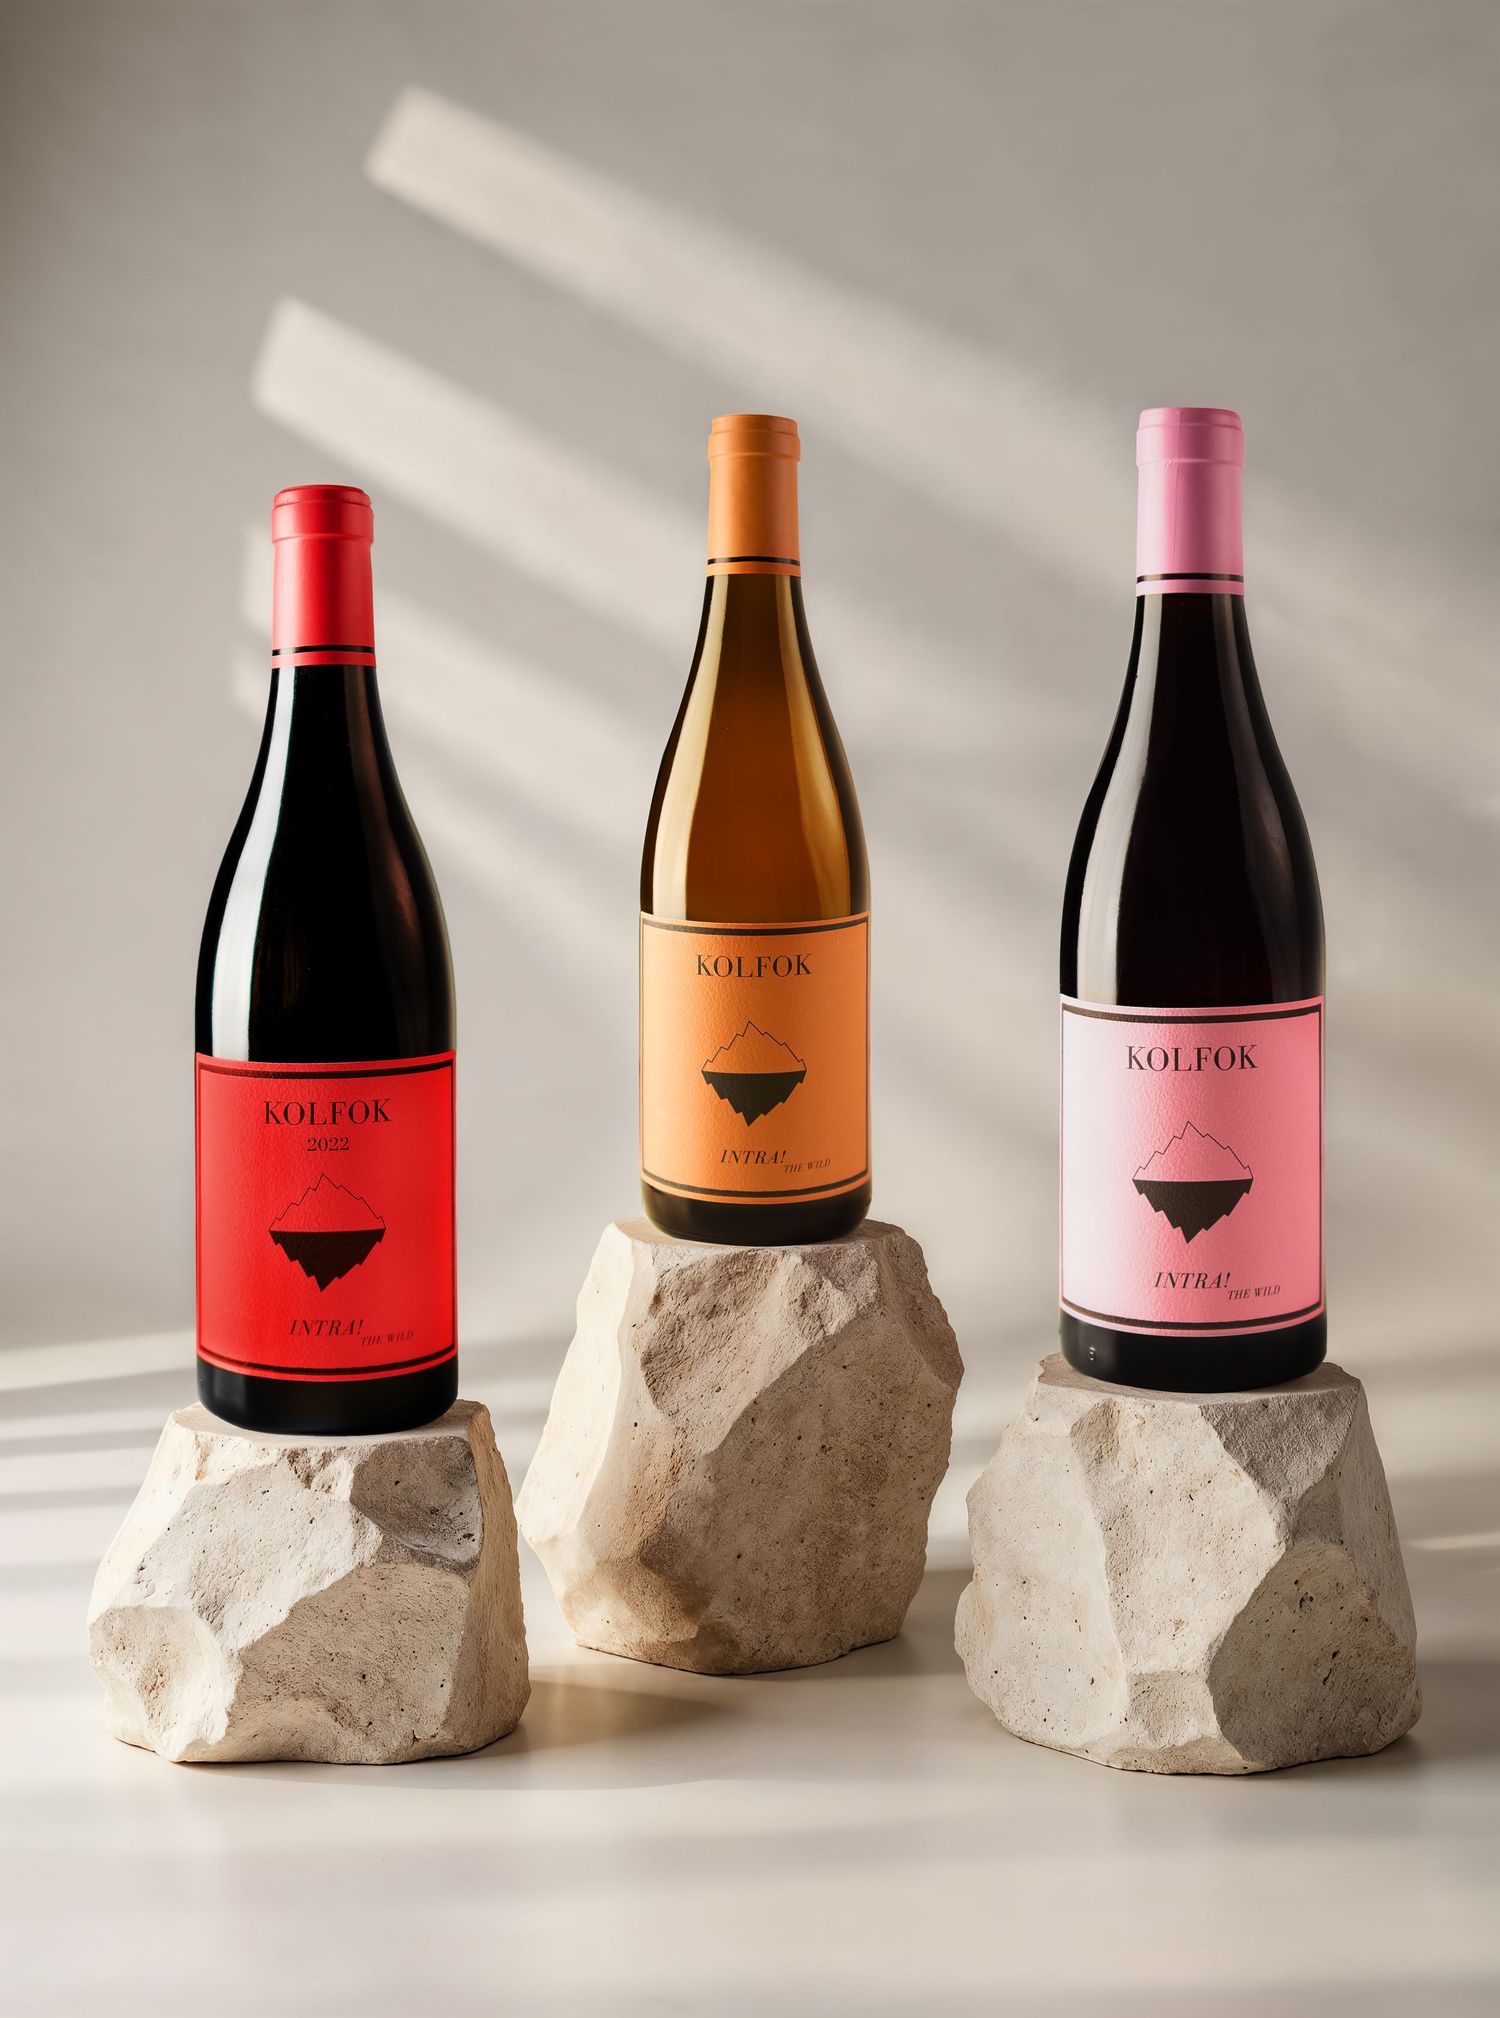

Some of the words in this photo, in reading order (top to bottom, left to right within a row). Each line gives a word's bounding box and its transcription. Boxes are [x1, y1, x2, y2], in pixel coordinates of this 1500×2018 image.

[695, 953, 813, 978] KOLFOK
[1126, 1044, 1258, 1072] KOLFOK
[264, 1098, 391, 1126] KOLFOK
[307, 1136, 350, 1151] 2022
[720, 1149, 787, 1164] INTRA!
[784, 1163, 804, 1173] THE
[807, 1158, 831, 1170] WILD
[1154, 1272, 1231, 1289] INTRA!
[1227, 1289, 1251, 1300] THE
[1254, 1285, 1281, 1297] WILD
[289, 1319, 364, 1336] INTRA!
[360, 1335, 382, 1346] THE
[386, 1330, 415, 1342] WILD
